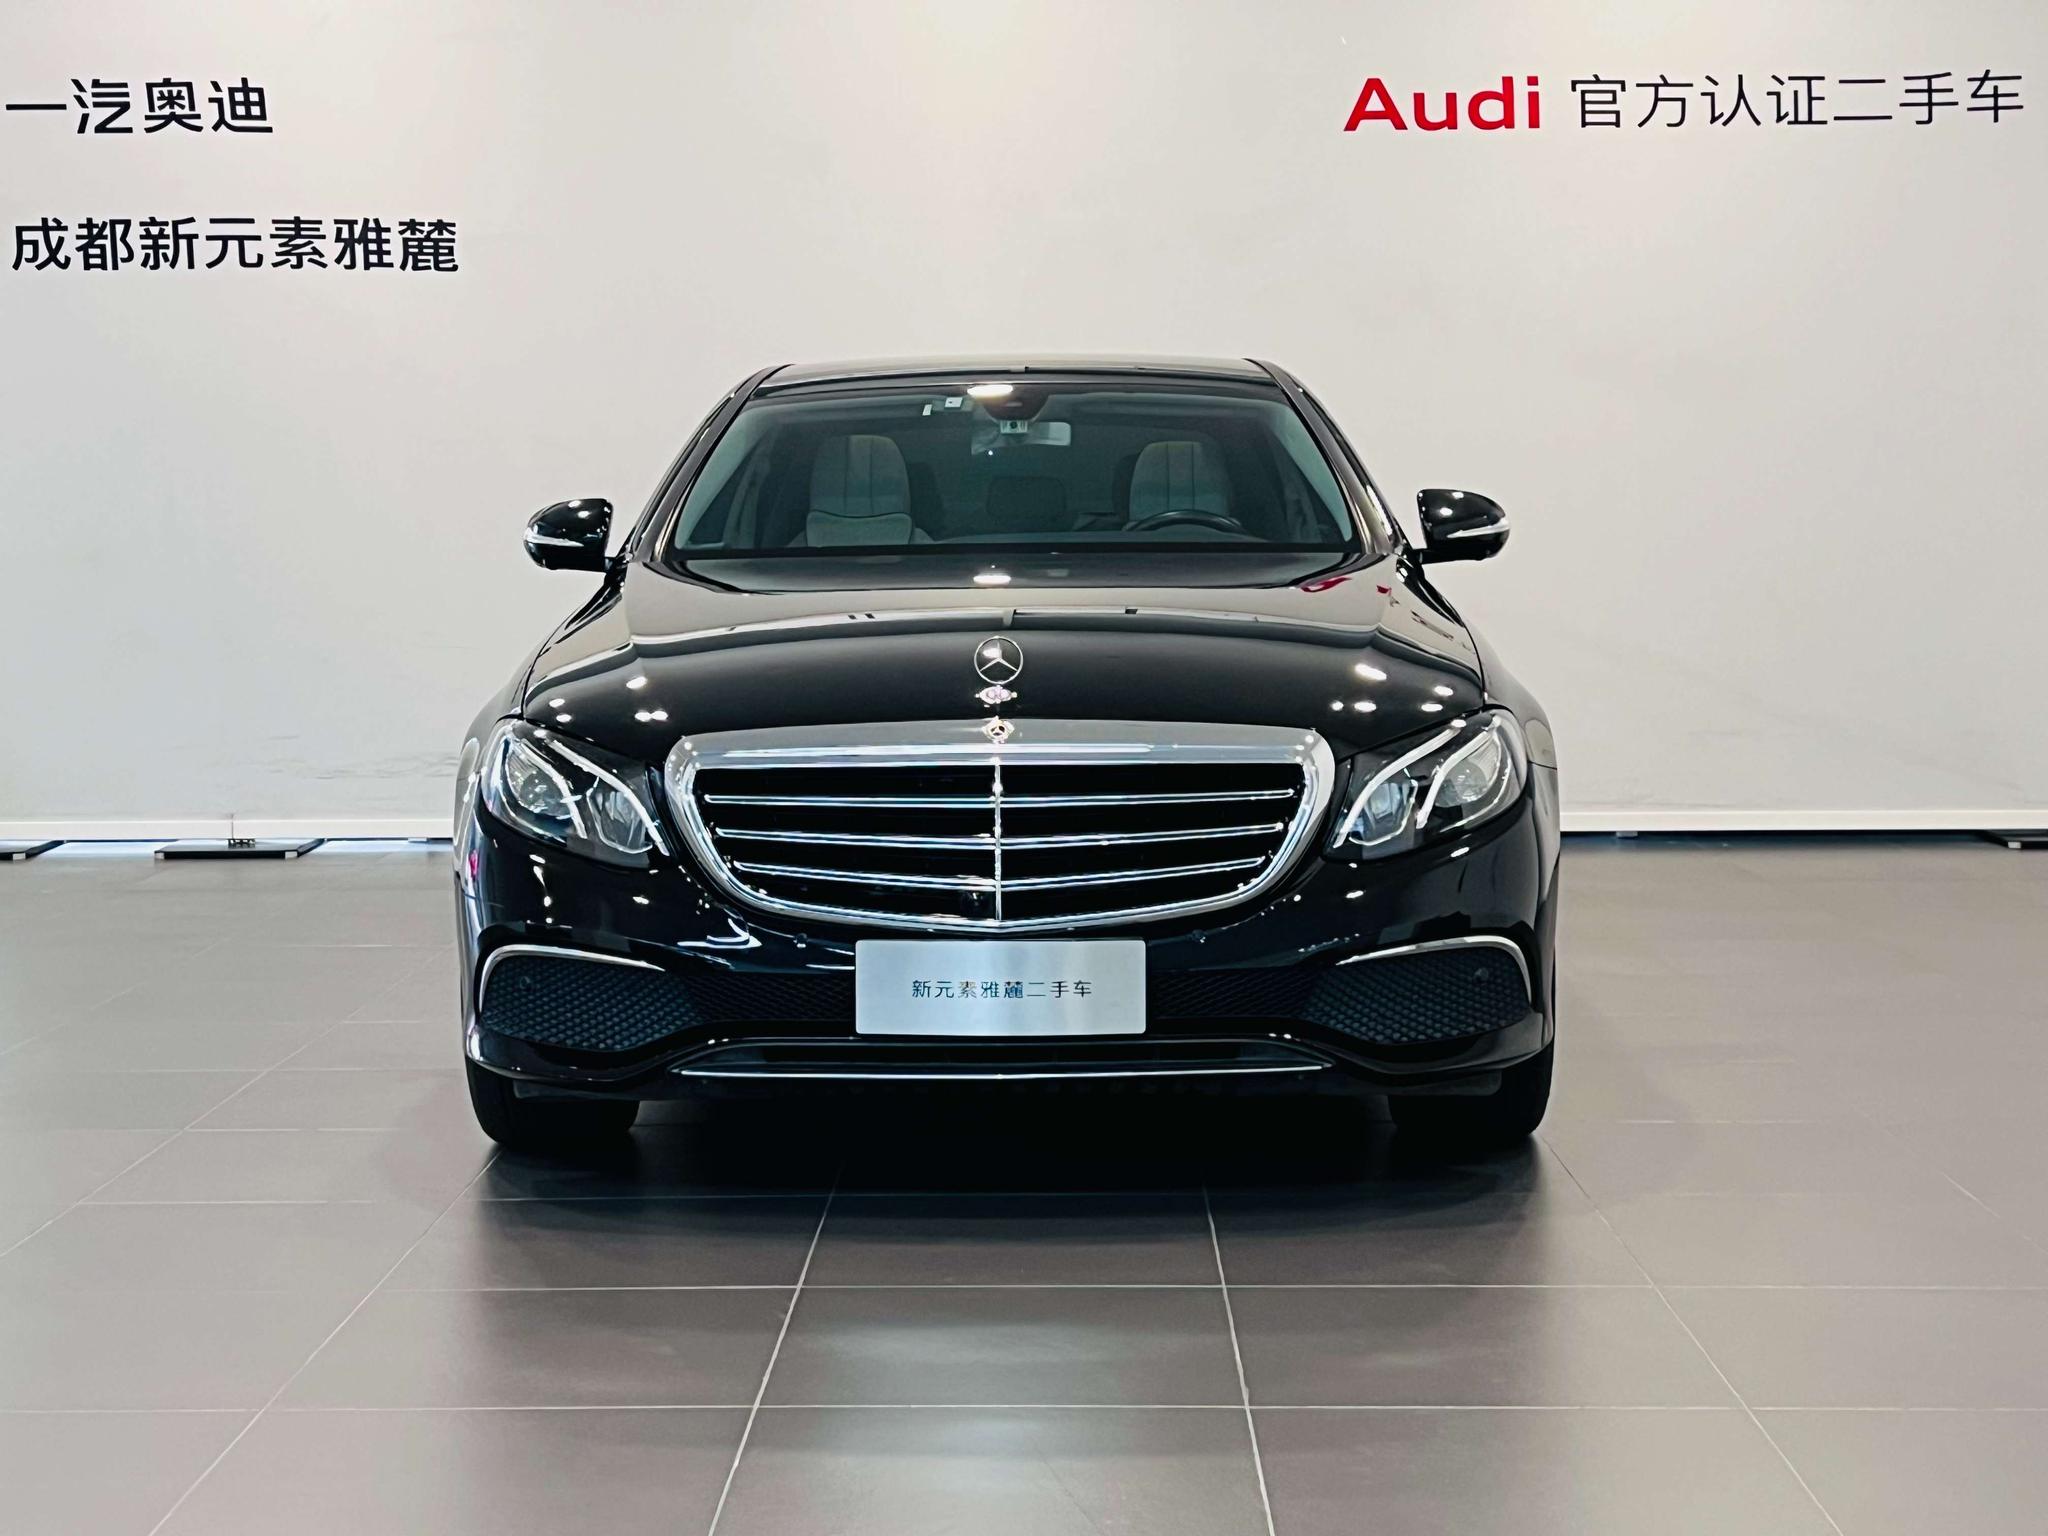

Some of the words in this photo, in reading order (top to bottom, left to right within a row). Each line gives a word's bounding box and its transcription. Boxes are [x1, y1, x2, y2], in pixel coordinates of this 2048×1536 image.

[6, 77, 273, 134] 一汽奥迪
[1344, 76, 1541, 132] Audi
[1570, 69, 2024, 128] 官方认证二手车
[12, 216, 459, 272] 成都新元素雅麓
[911, 979, 1092, 999] 新元素雅麓二手车
